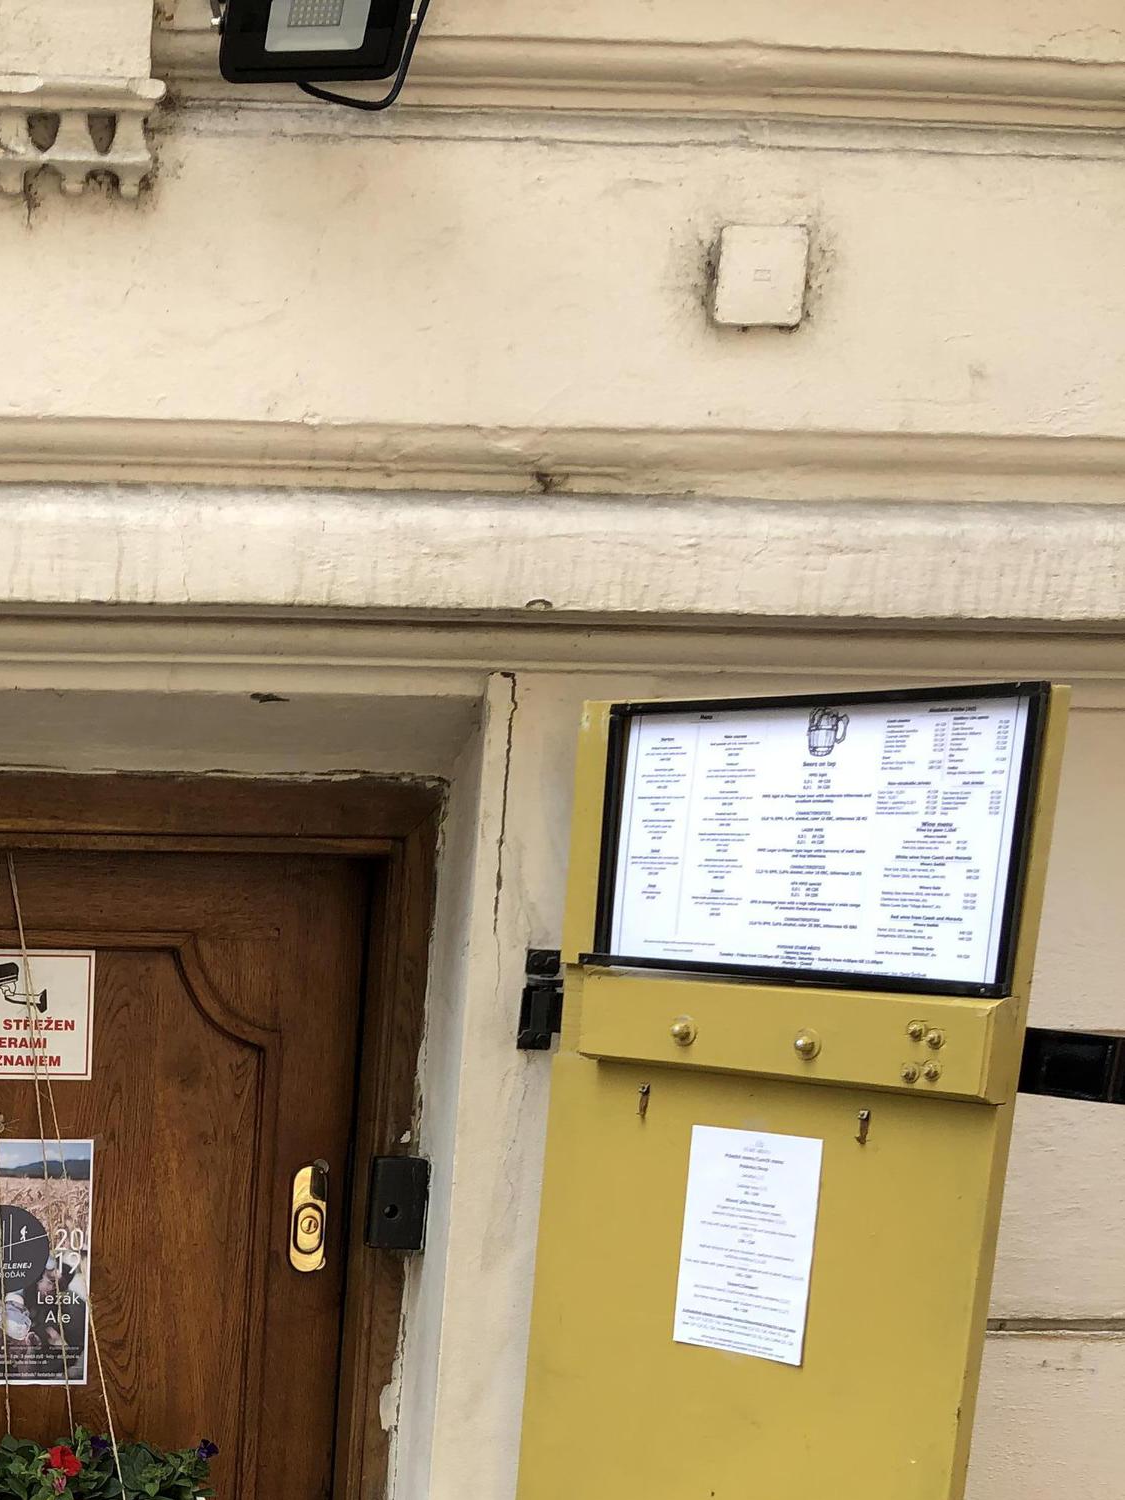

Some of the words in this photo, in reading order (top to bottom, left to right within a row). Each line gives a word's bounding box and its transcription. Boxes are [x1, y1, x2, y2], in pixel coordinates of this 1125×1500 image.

[3, 1016, 75, 1031] STŘEŽEN
[55, 1228, 83, 1250] 20
[55, 1252, 81, 1274] 19
